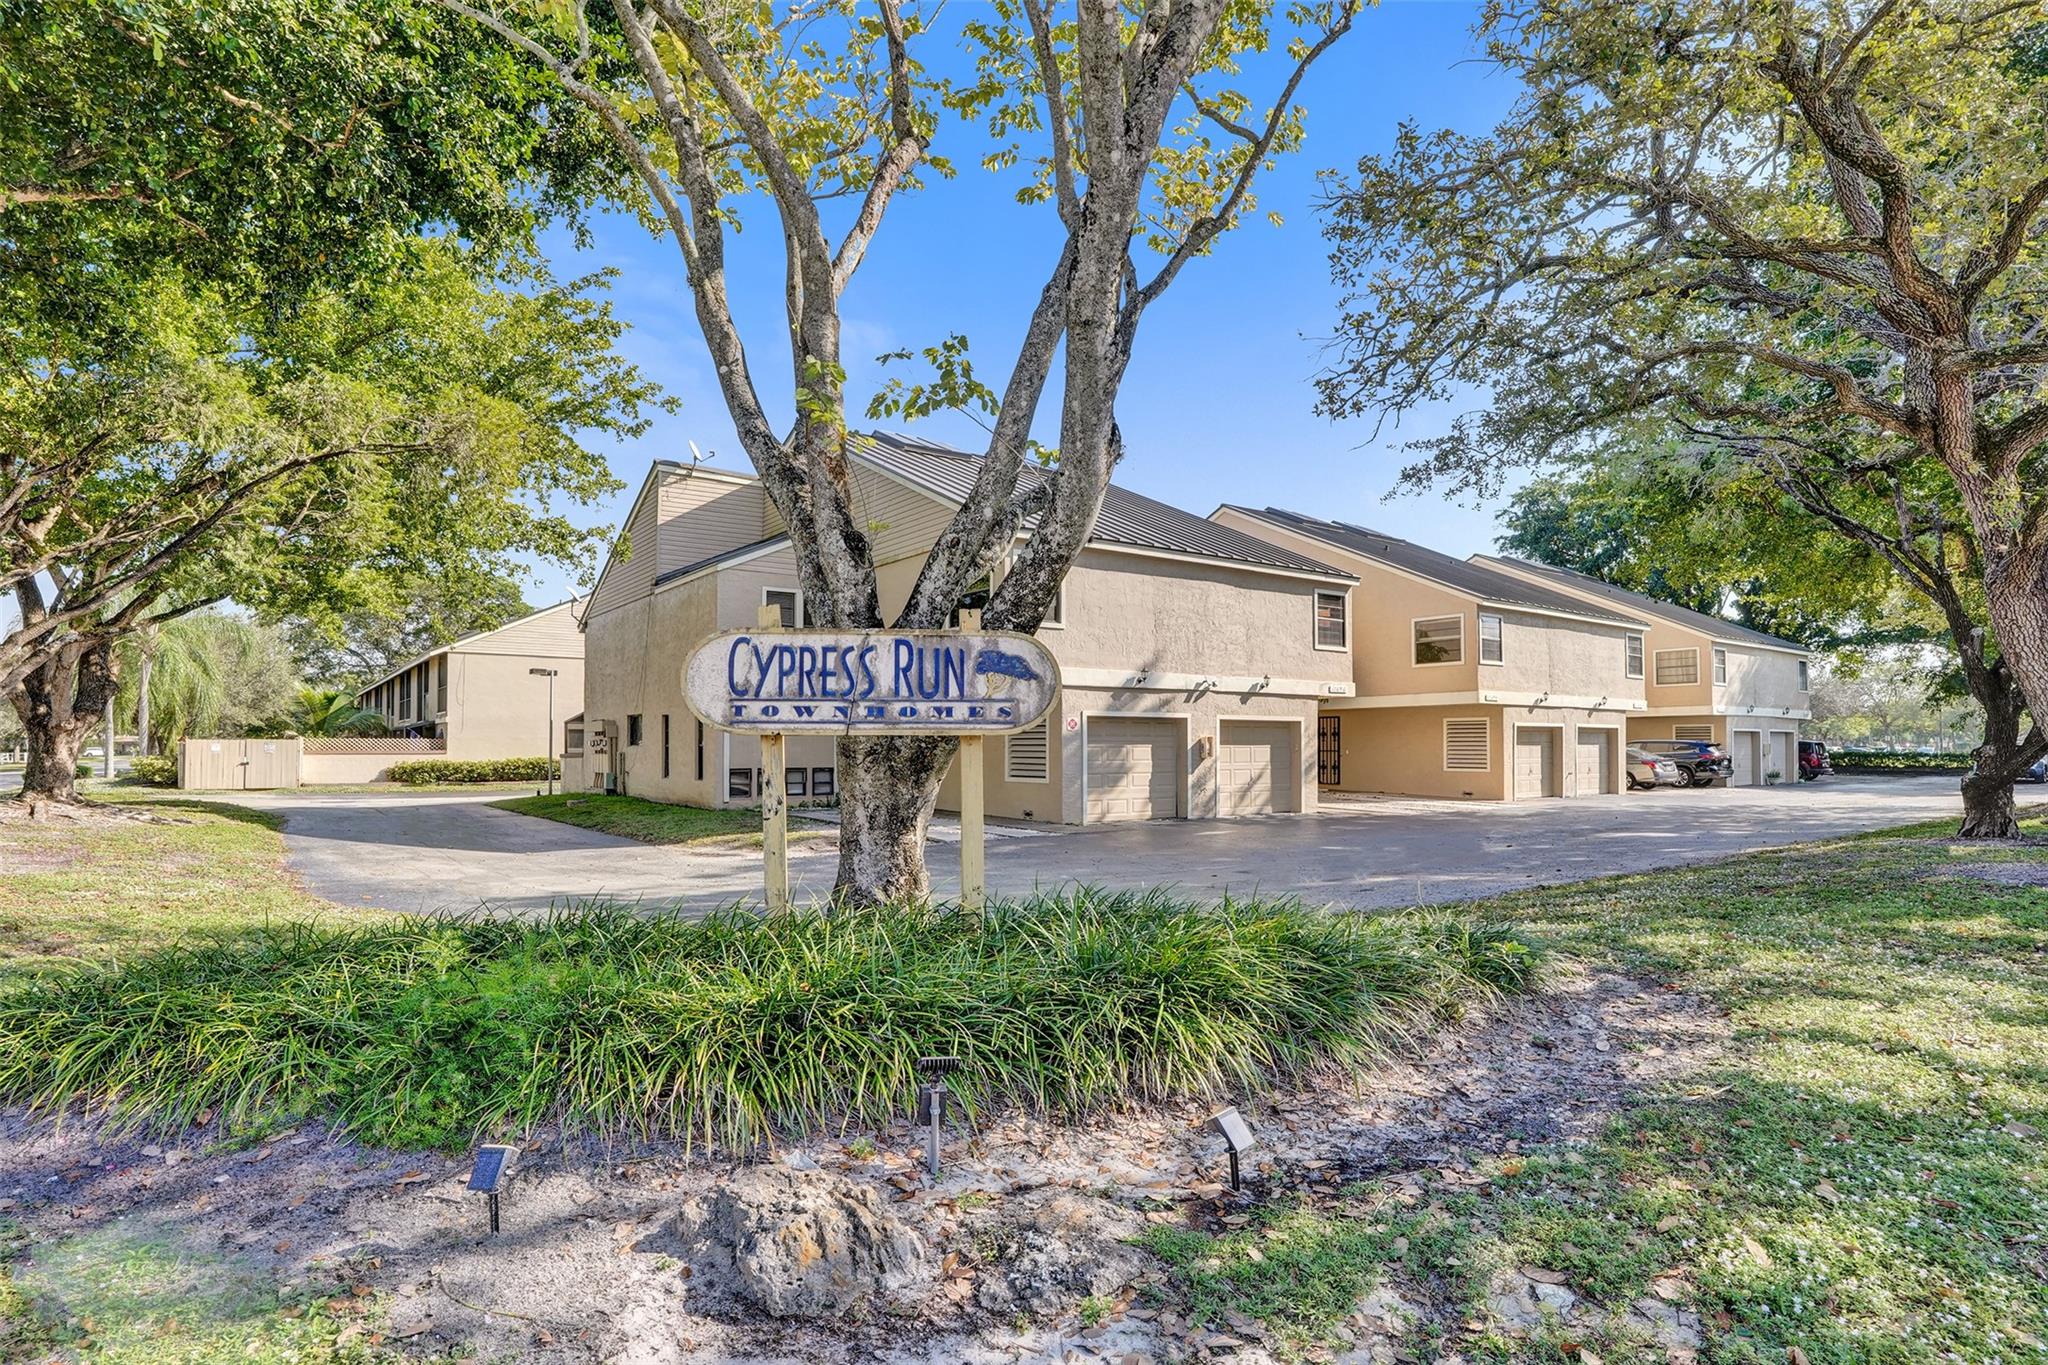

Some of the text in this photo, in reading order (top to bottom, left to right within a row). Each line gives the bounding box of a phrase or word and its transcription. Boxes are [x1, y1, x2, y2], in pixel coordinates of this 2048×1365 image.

[728, 636, 966, 700] CYPRESS RUN
[730, 704, 1014, 719] TOWNHOMES
